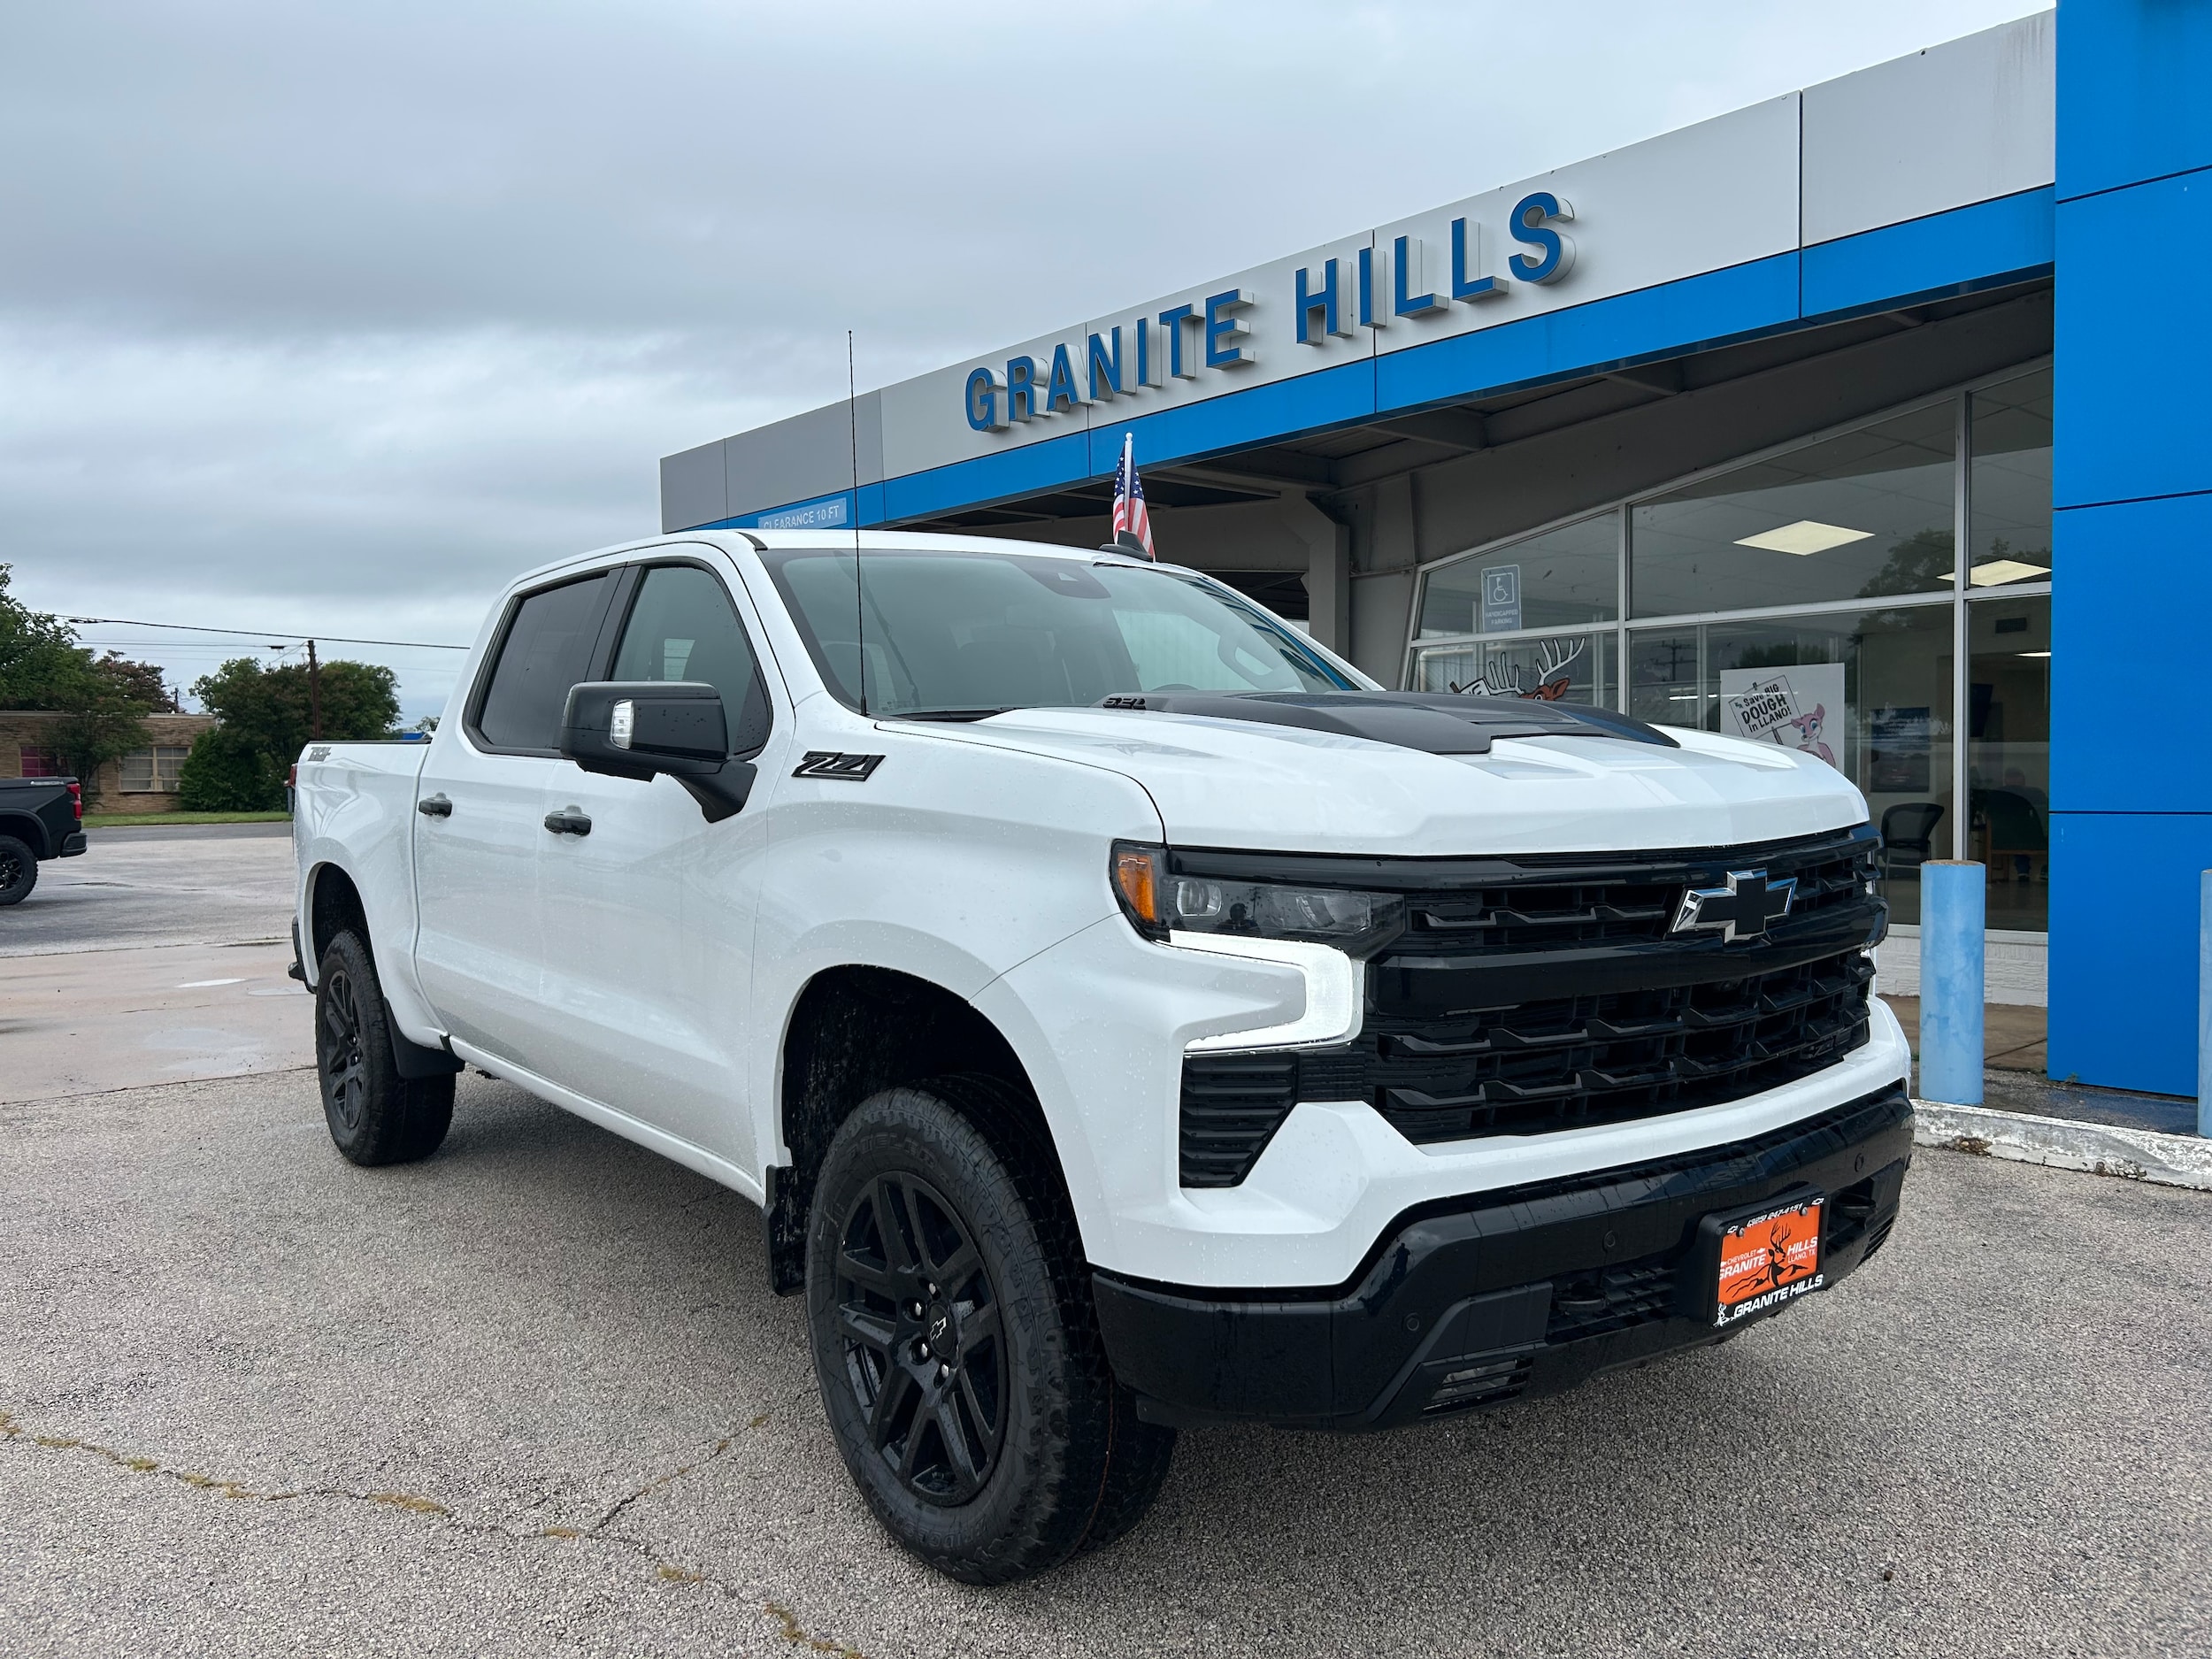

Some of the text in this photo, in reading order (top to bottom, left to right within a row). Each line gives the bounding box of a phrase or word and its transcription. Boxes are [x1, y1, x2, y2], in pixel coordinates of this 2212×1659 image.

[965, 191, 1574, 433] GRANITE HILLS
[817, 509, 826, 521] 10
[828, 505, 840, 519] FT
[1486, 609, 1518, 618] HANDICAPPED
[1764, 684, 1779, 696] BIG
[1741, 694, 1787, 725] DOUGH
[1758, 705, 1792, 727] LLANO!
[791, 750, 887, 782] Z71
[1787, 1236, 1817, 1256] HILLS
[1727, 1249, 1757, 1265] CHEVROLET
[1733, 1273, 1824, 1318] GRANITE HILLS
